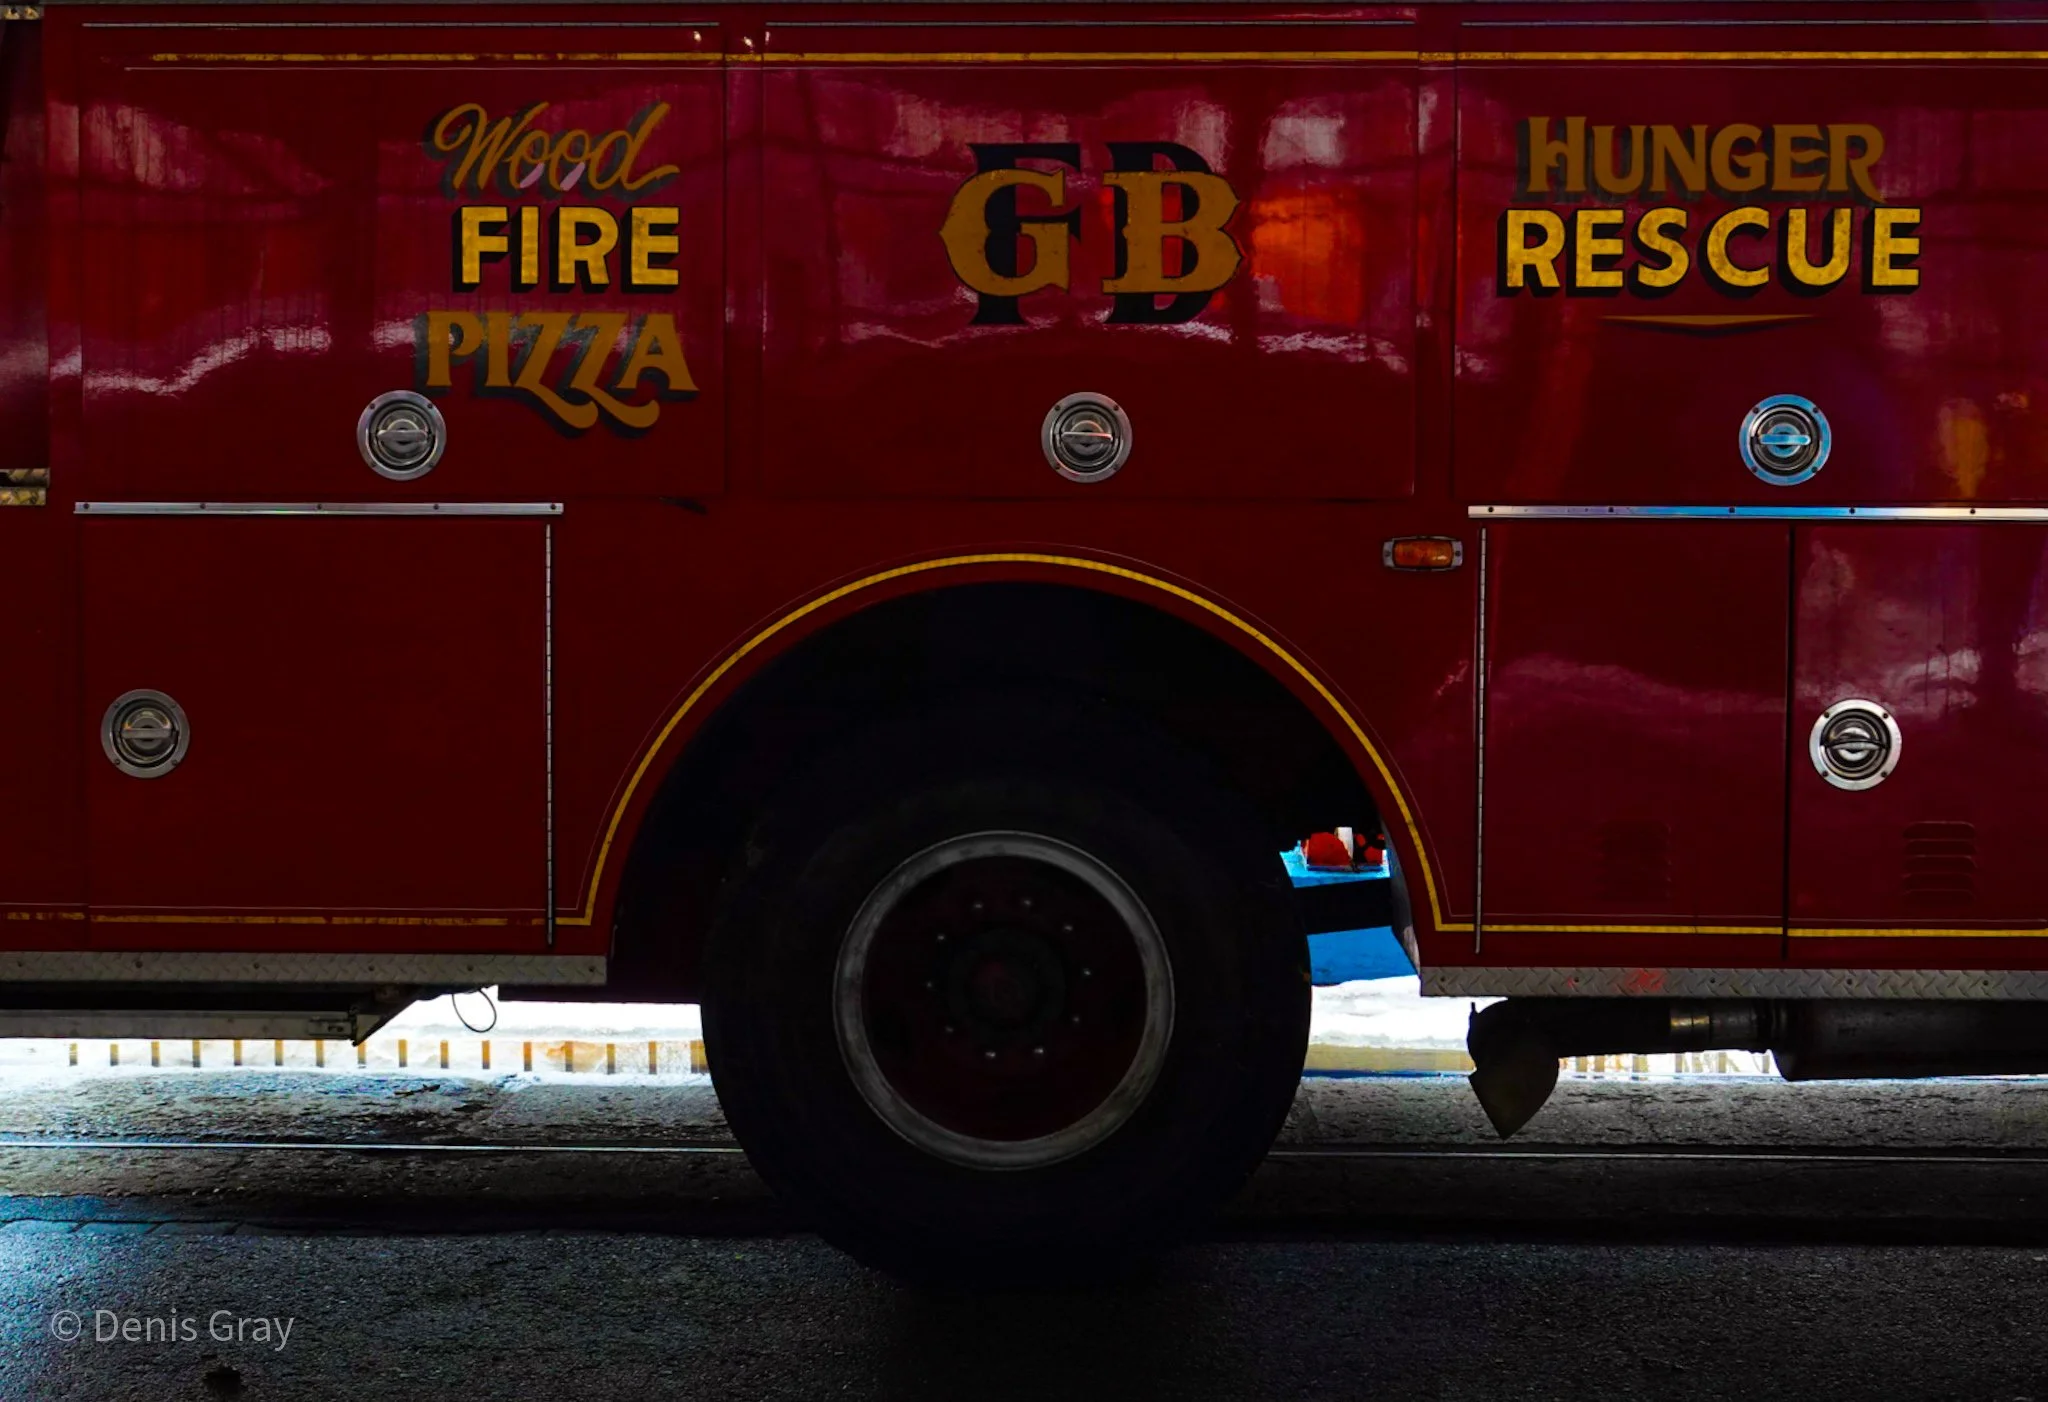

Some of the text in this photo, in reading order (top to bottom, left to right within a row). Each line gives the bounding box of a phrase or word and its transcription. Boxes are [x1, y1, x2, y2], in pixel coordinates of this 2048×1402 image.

[432, 101, 680, 190] Wood
[1526, 115, 1886, 203] HUNGER
[458, 205, 680, 286] FIRE
[939, 168, 1241, 297] GB
[1504, 206, 1922, 288] RESCUE
[426, 309, 700, 430] PIZZA
